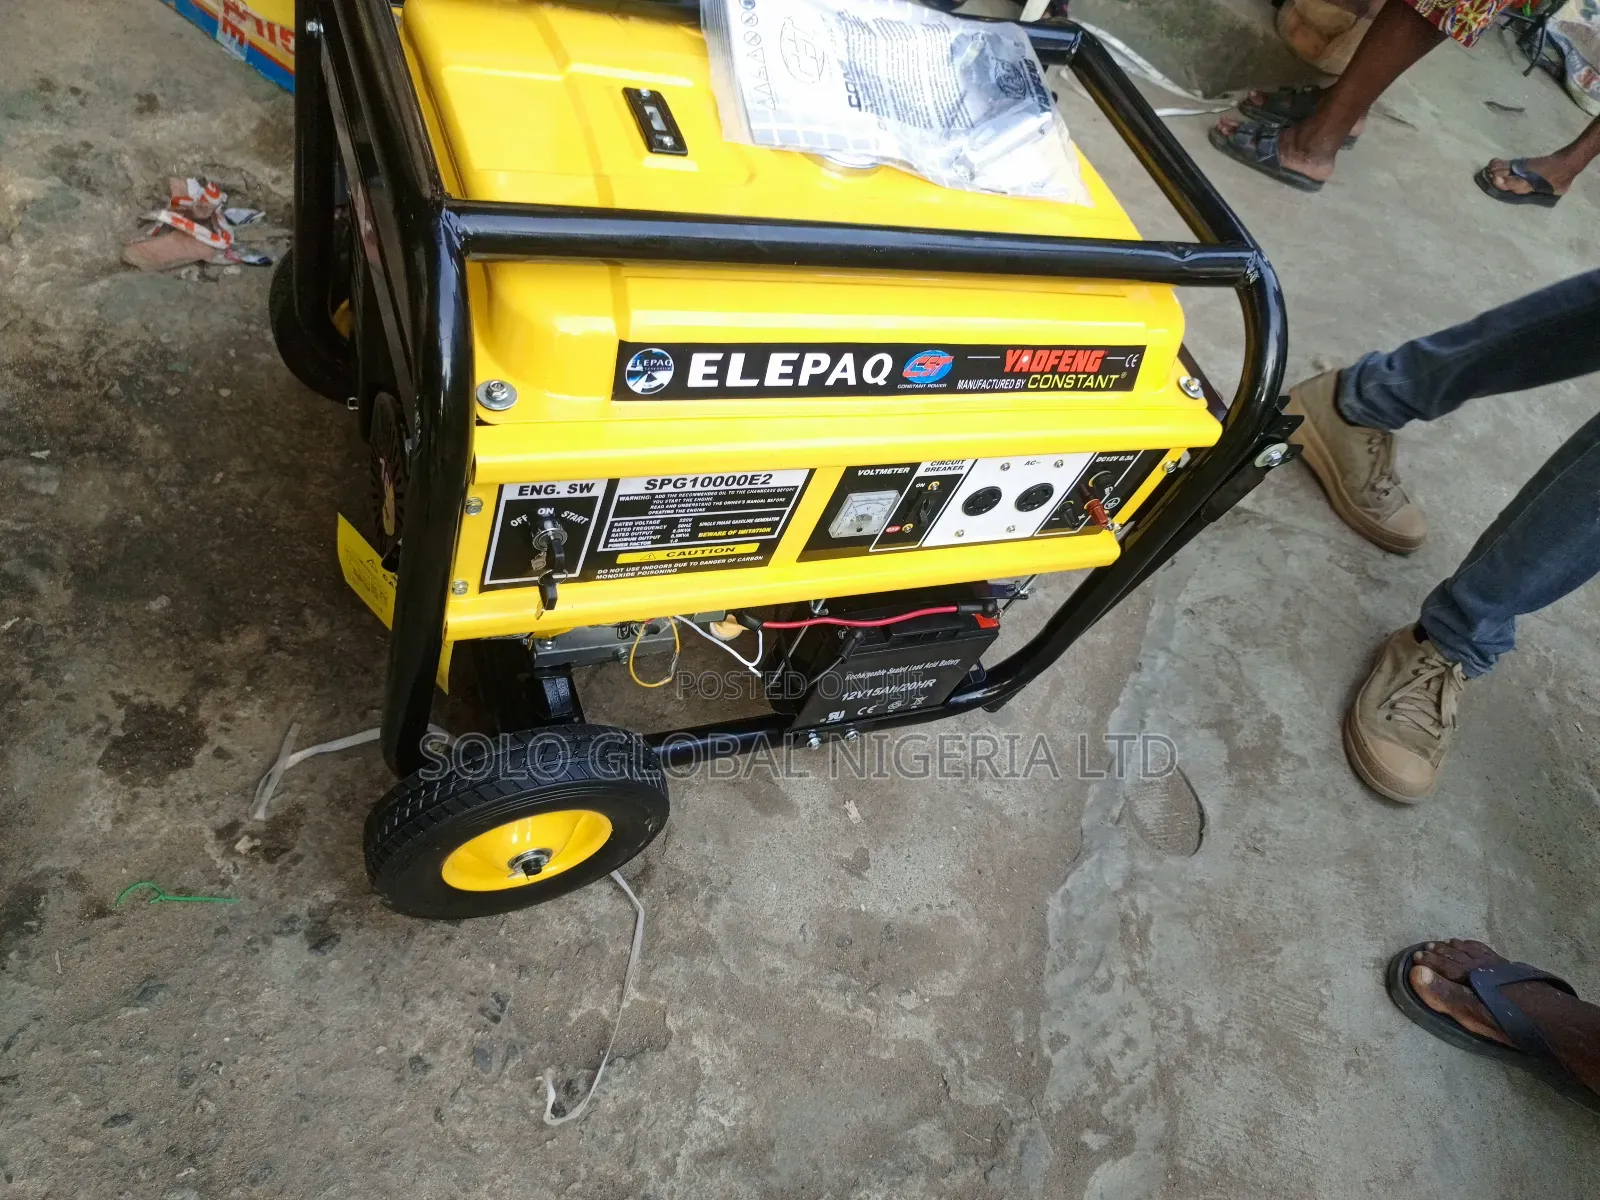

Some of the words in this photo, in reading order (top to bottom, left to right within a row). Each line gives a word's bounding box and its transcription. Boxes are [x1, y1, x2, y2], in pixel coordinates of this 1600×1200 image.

[631, 359, 672, 367] ELEPAQ
[1004, 350, 1106, 372] YAOFENG
[687, 352, 893, 388] ELEPAQ
[957, 379, 1015, 390] MANUFACTURED
[1015, 379, 1026, 389] BY
[924, 465, 964, 473] BREAKER
[930, 459, 965, 467] CIRCUIT
[857, 467, 910, 476] VOLTMETER
[644, 474, 773, 491] SPG10000E2
[518, 485, 560, 496] ENG.
[567, 483, 595, 494] SW
[510, 514, 528, 527] OFF
[561, 510, 589, 525] START
[698, 530, 727, 538] BEWARE
[738, 527, 771, 535] IMITATION
[666, 547, 736, 557] CAUTION
[642, 563, 673, 571] INDOORS
[596, 572, 635, 580] MONOXIDE
[637, 568, 677, 576] POISONING
[887, 665, 908, 674] Sealed
[909, 662, 923, 671] Lead
[923, 661, 938, 669] Acid
[938, 658, 961, 668] Battery
[842, 679, 937, 702] 12V15Ah/20HR
